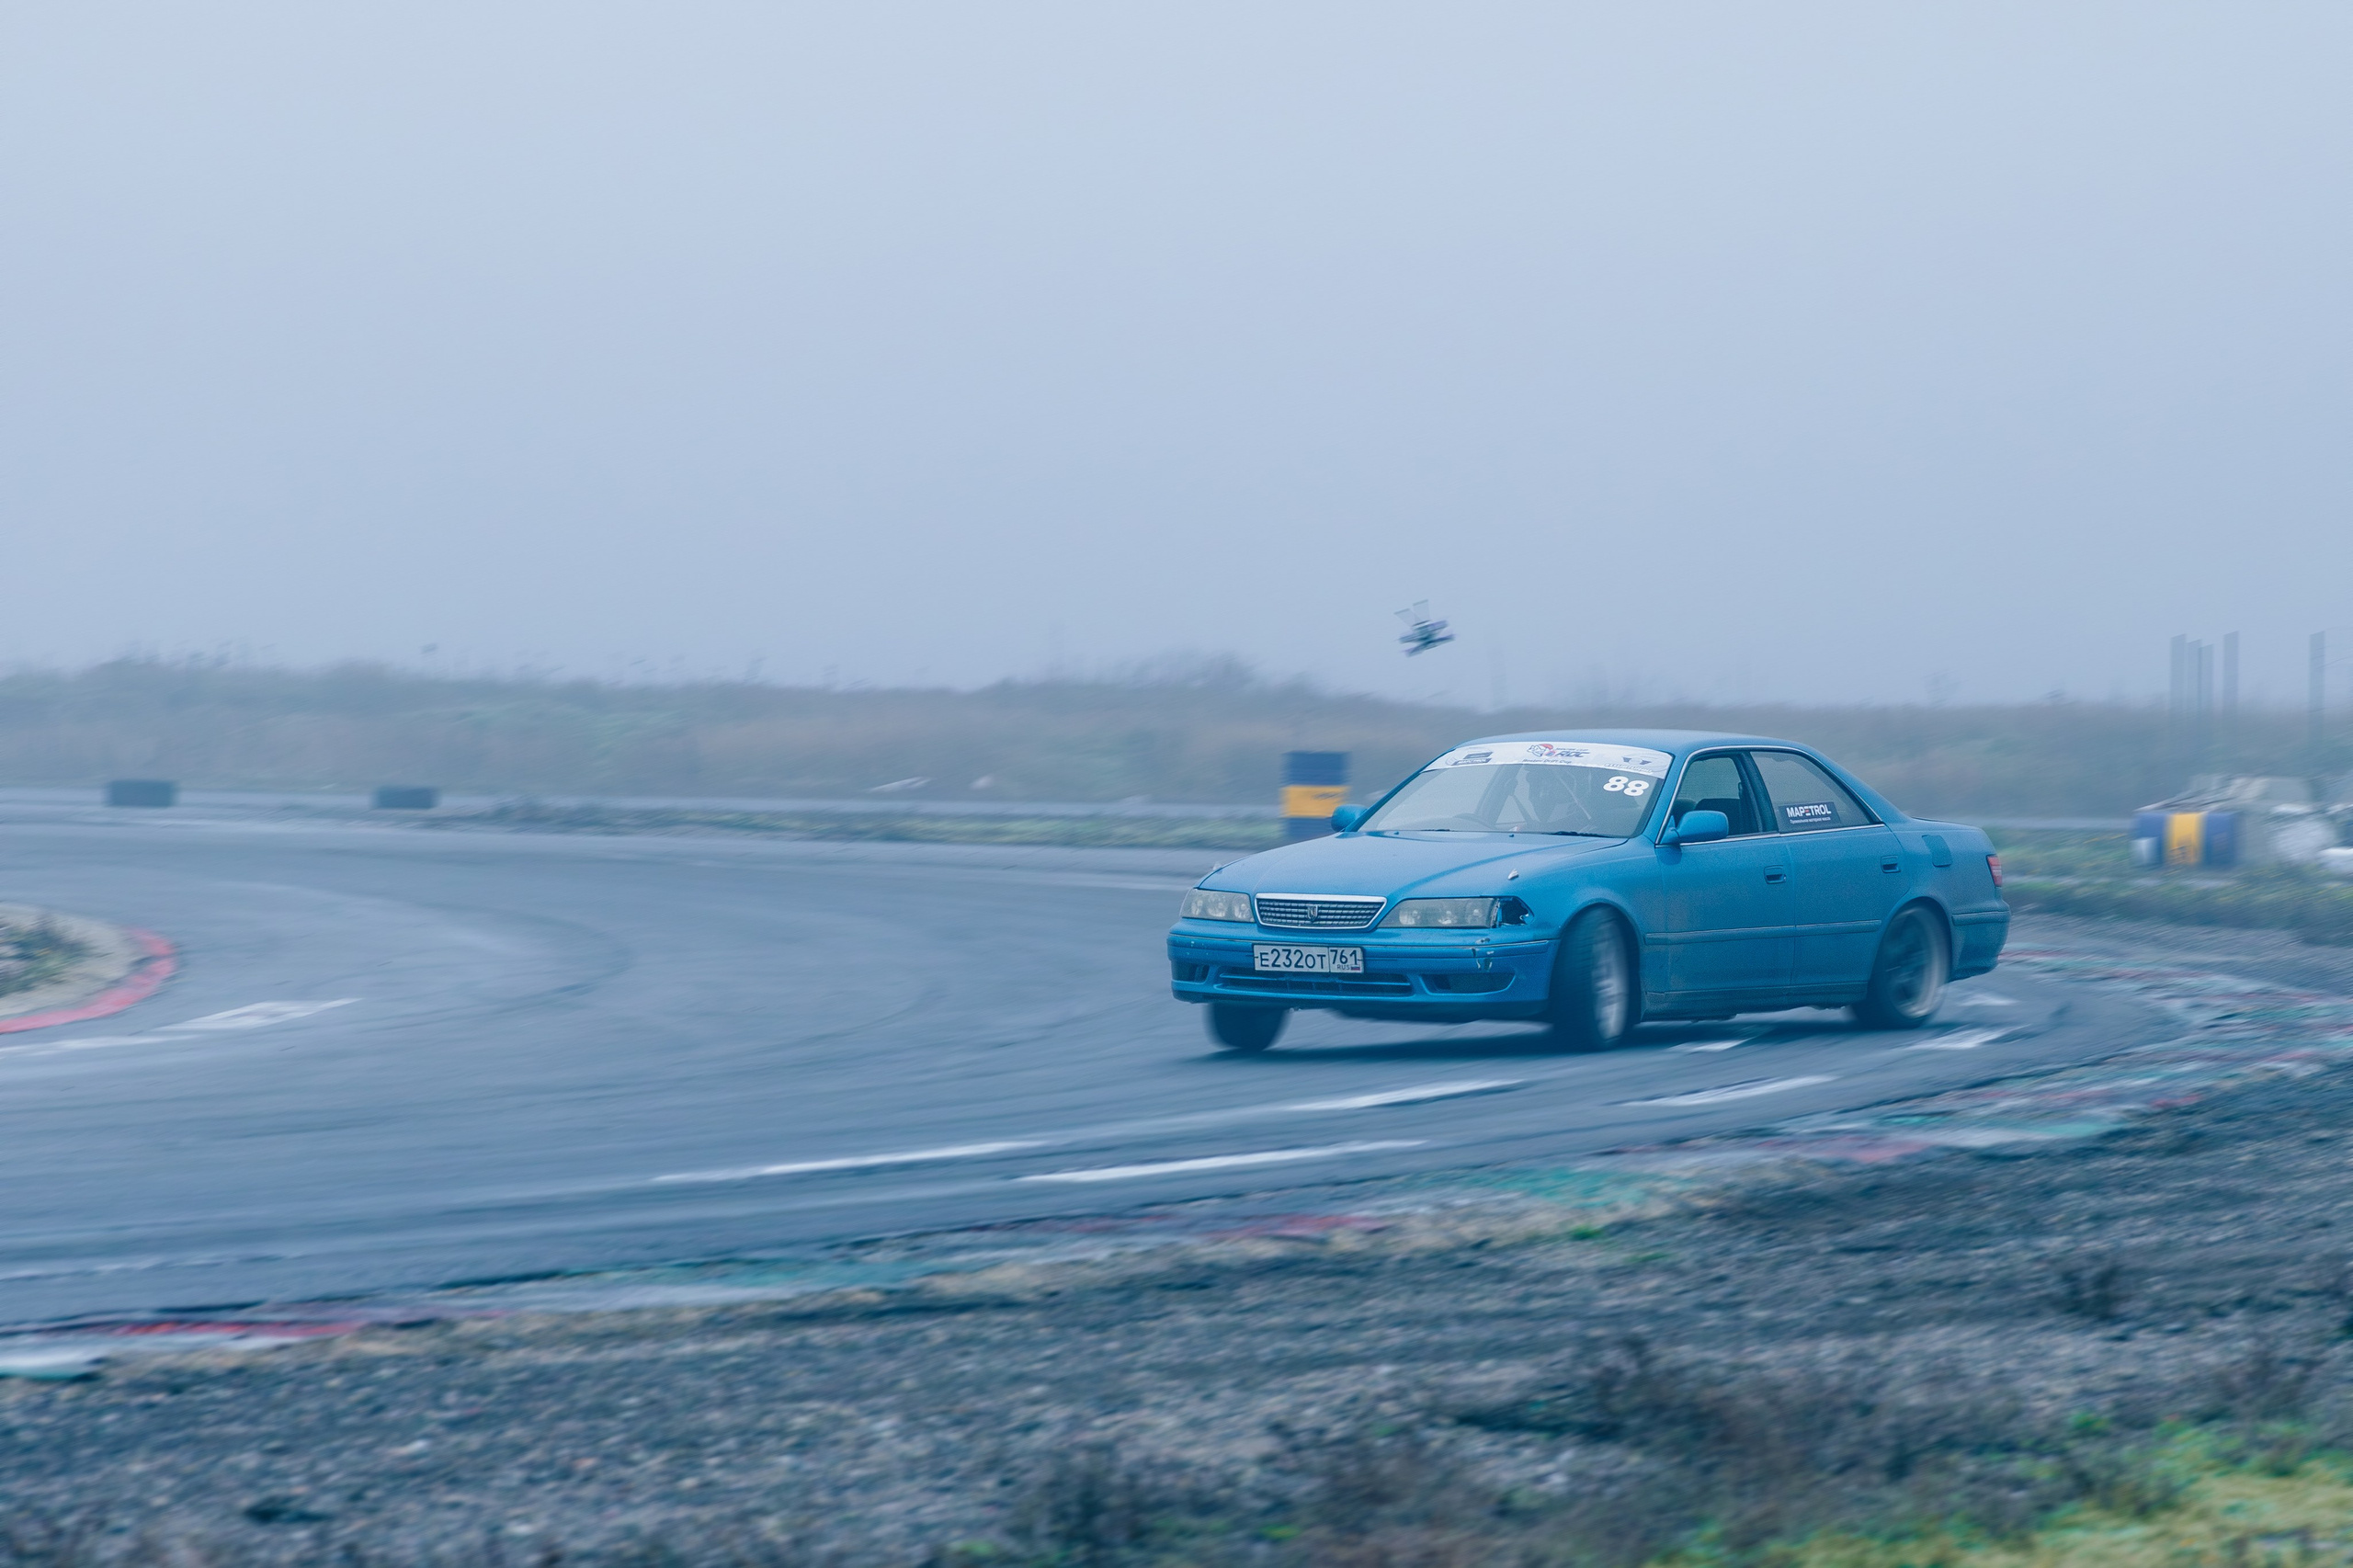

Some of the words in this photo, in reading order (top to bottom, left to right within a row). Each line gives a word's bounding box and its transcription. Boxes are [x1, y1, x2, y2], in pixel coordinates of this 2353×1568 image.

[1603, 776, 1649, 797] 88
[1786, 804, 1832, 817] MAPETROL
[1259, 949, 1326, 969] E232OT
[1330, 949, 1358, 965] 761
